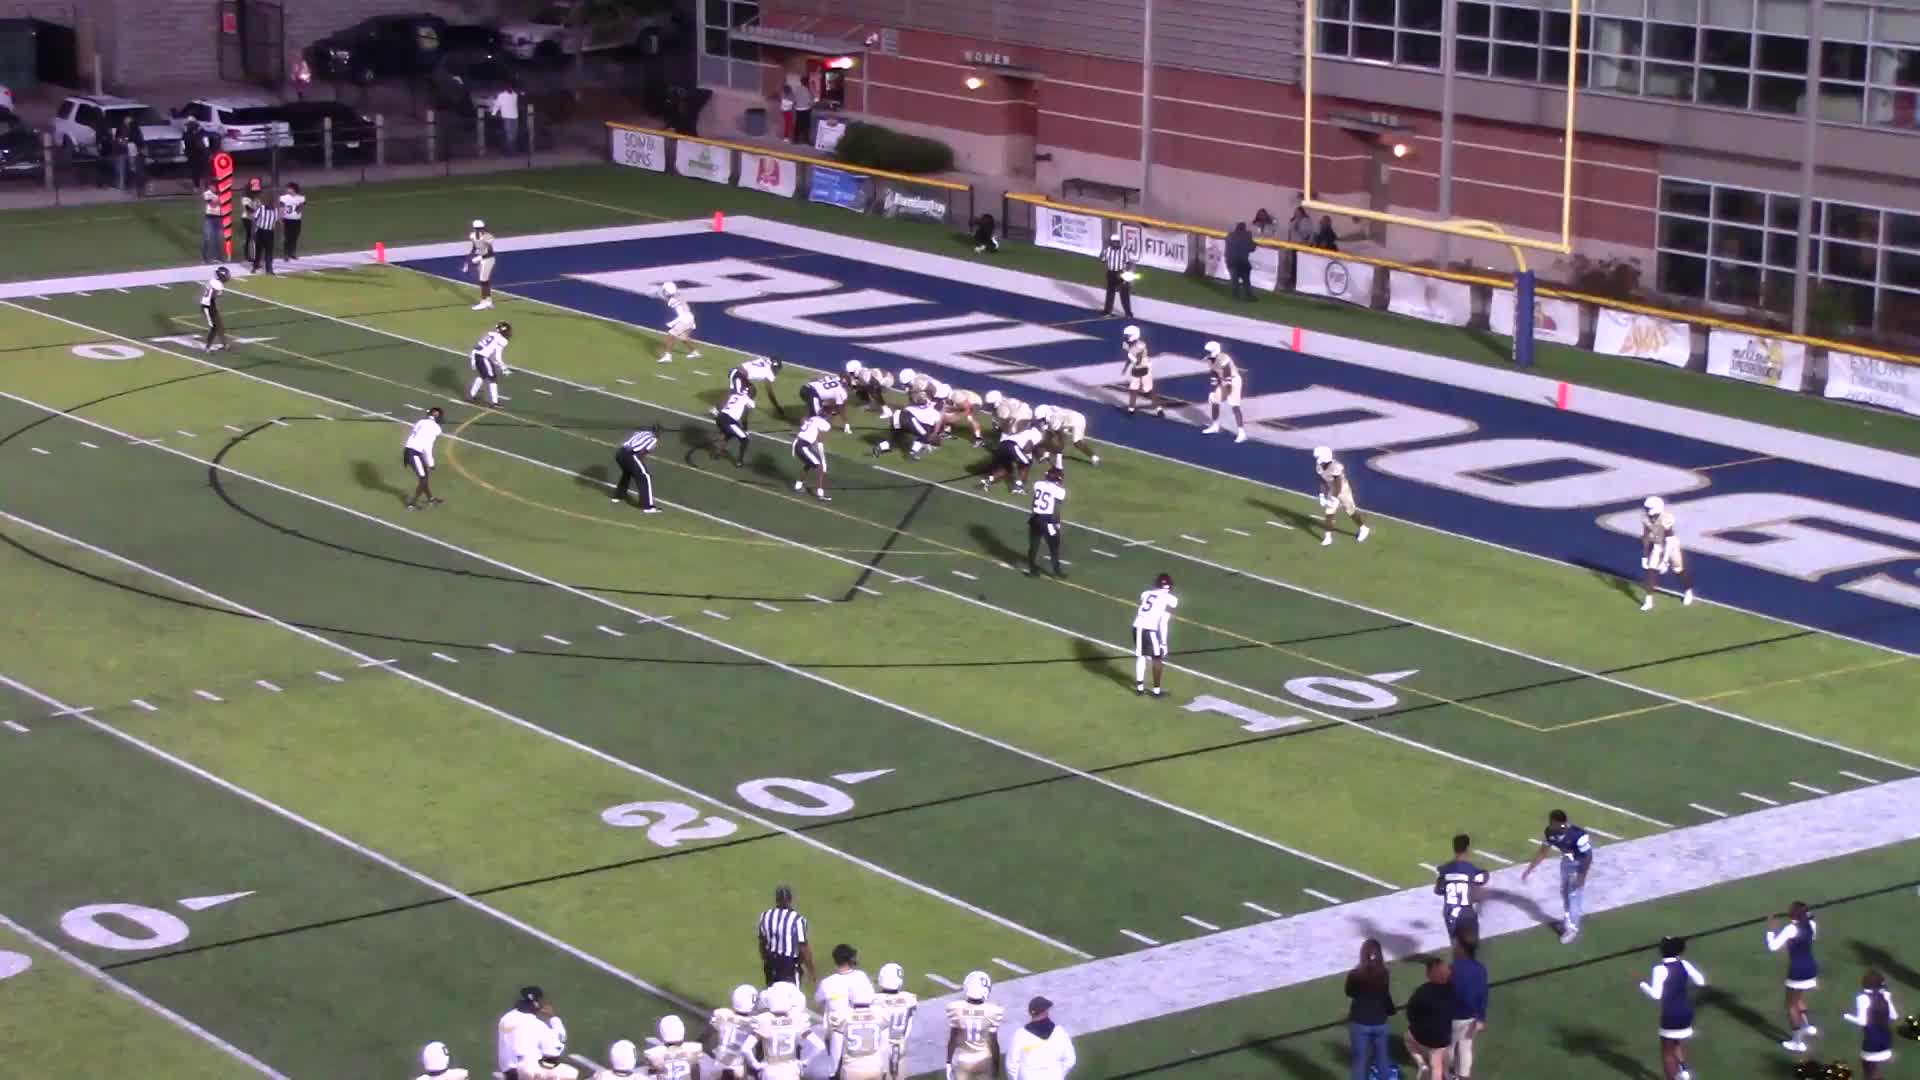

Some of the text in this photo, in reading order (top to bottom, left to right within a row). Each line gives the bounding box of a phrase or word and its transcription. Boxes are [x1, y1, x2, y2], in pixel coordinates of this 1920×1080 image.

[1145, 239, 1186, 261] FITWIT
[1180, 675, 1398, 733] 10
[600, 776, 857, 848] 20
[1445, 882, 1470, 905] 27
